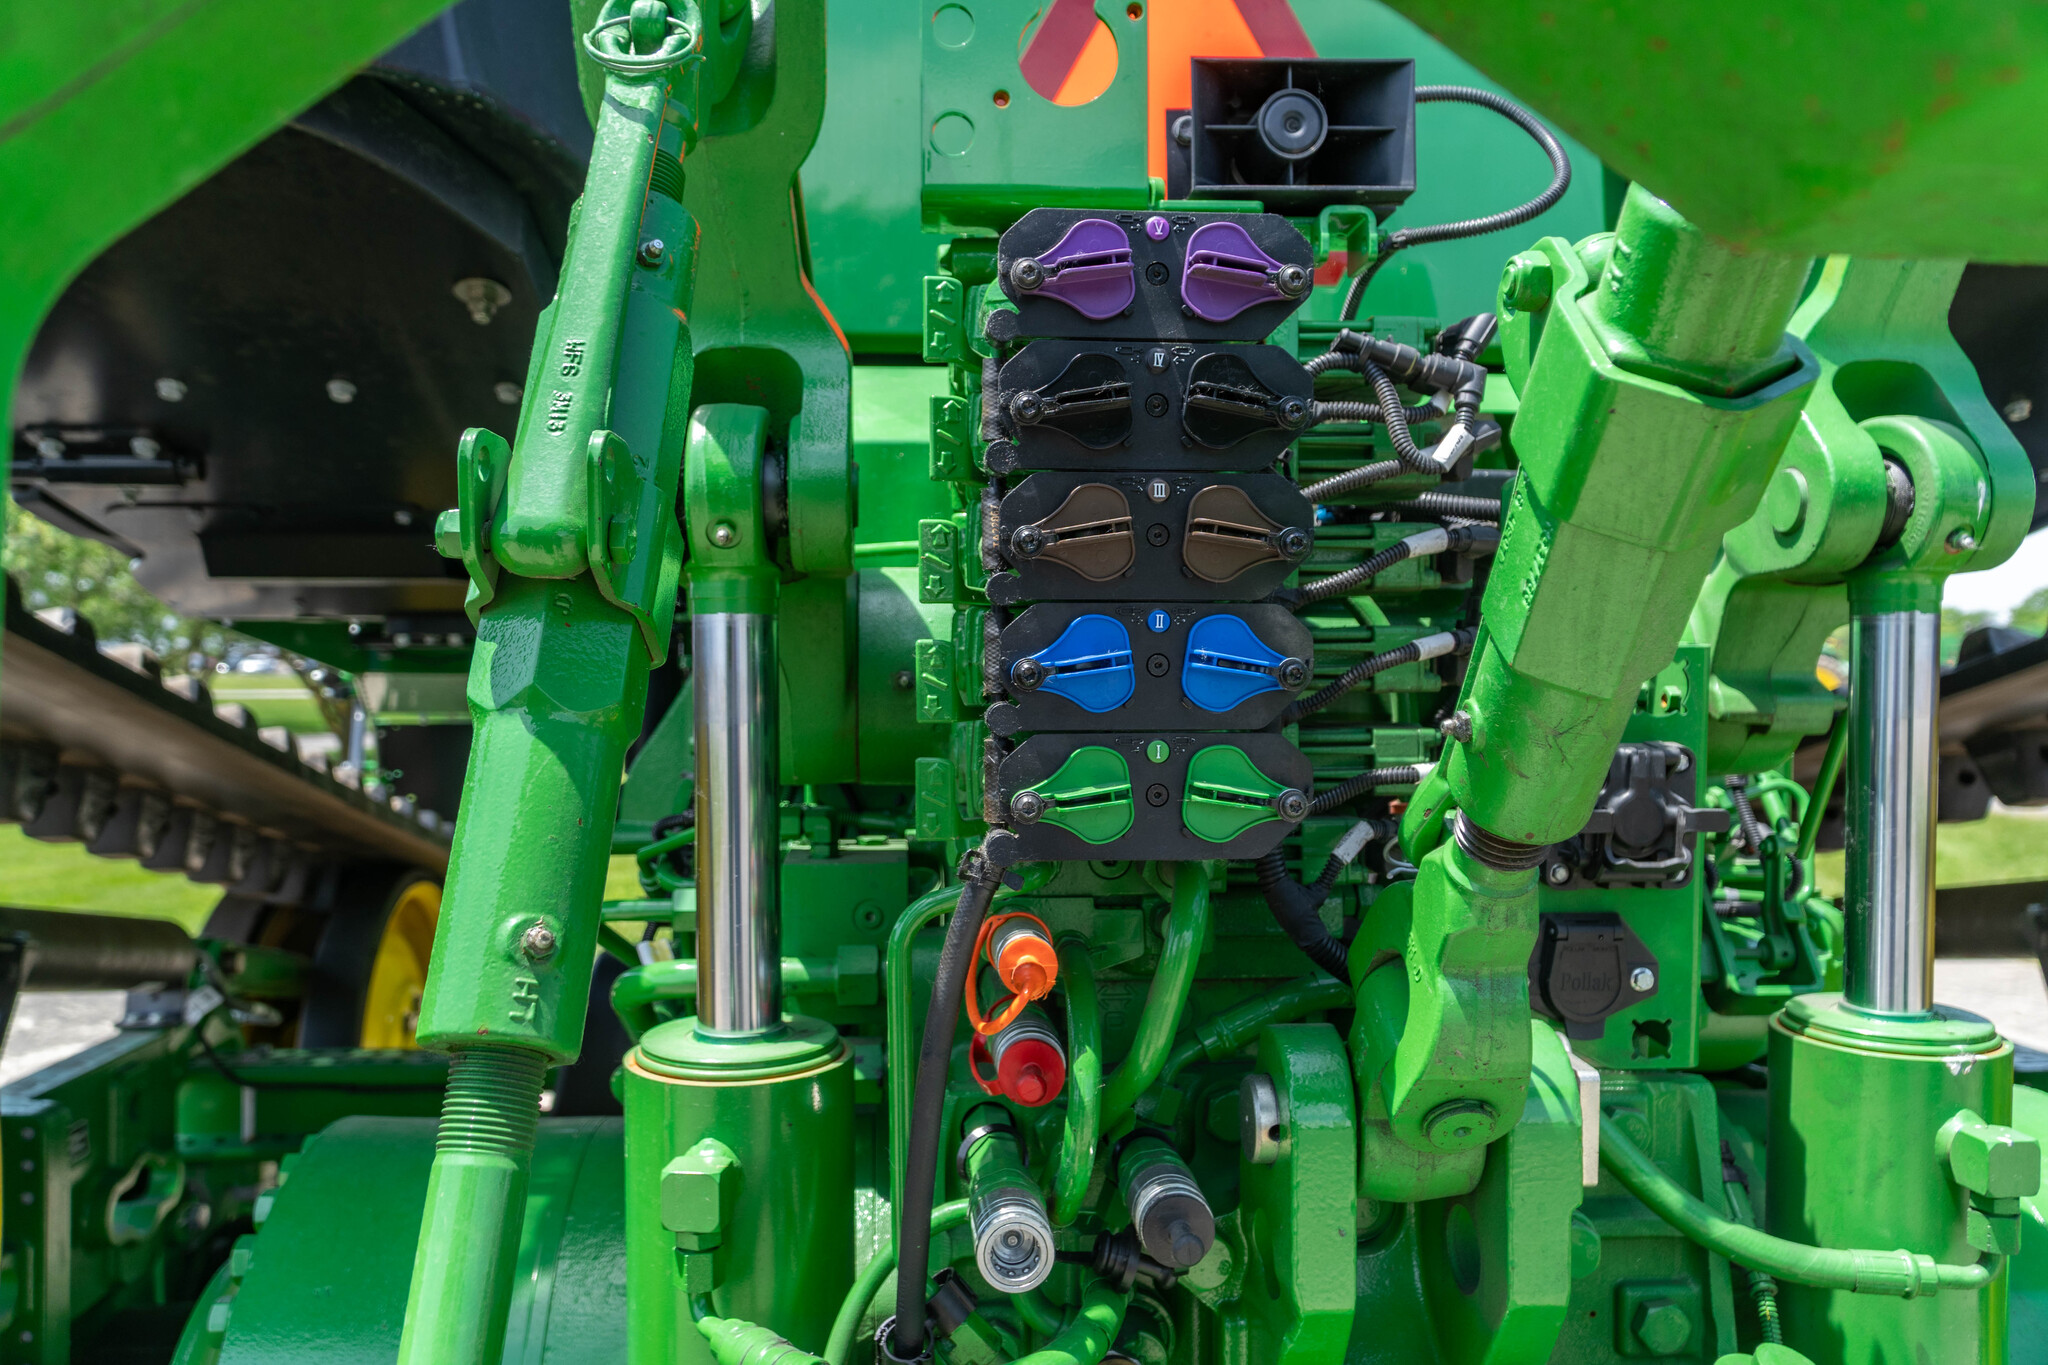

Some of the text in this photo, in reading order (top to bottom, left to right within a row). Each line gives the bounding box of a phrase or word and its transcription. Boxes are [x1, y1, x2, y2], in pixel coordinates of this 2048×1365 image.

[1154, 220, 1165, 235] V
[1153, 352, 1165, 367] IV
[1153, 483, 1166, 498] III
[1155, 614, 1165, 629] II
[1560, 972, 1614, 992] Pollak
